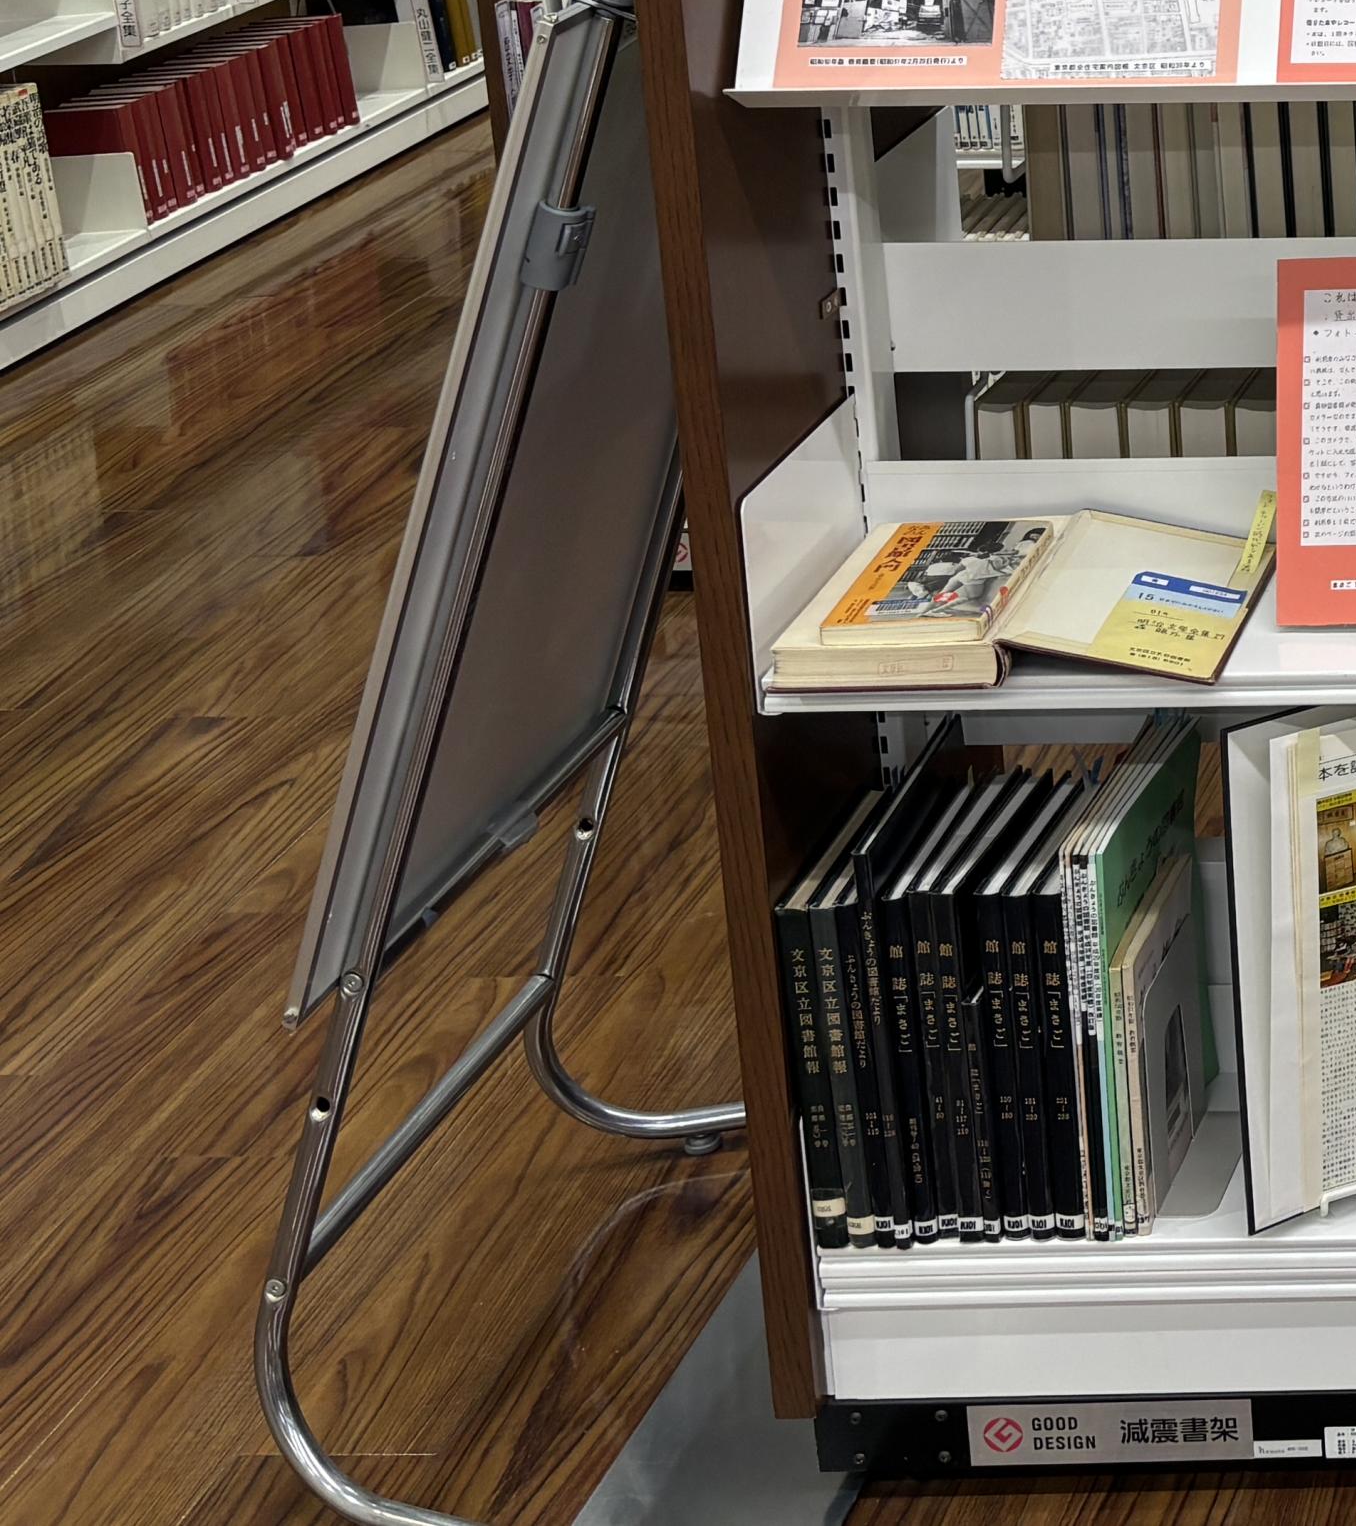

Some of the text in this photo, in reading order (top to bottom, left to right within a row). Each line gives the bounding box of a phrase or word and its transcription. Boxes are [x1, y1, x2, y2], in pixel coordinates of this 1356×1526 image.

[1031, 1416, 1079, 1432] GOOD
[1120, 1416, 1239, 1445] 減震書架
[1033, 1434, 1096, 1451] DESIGN
